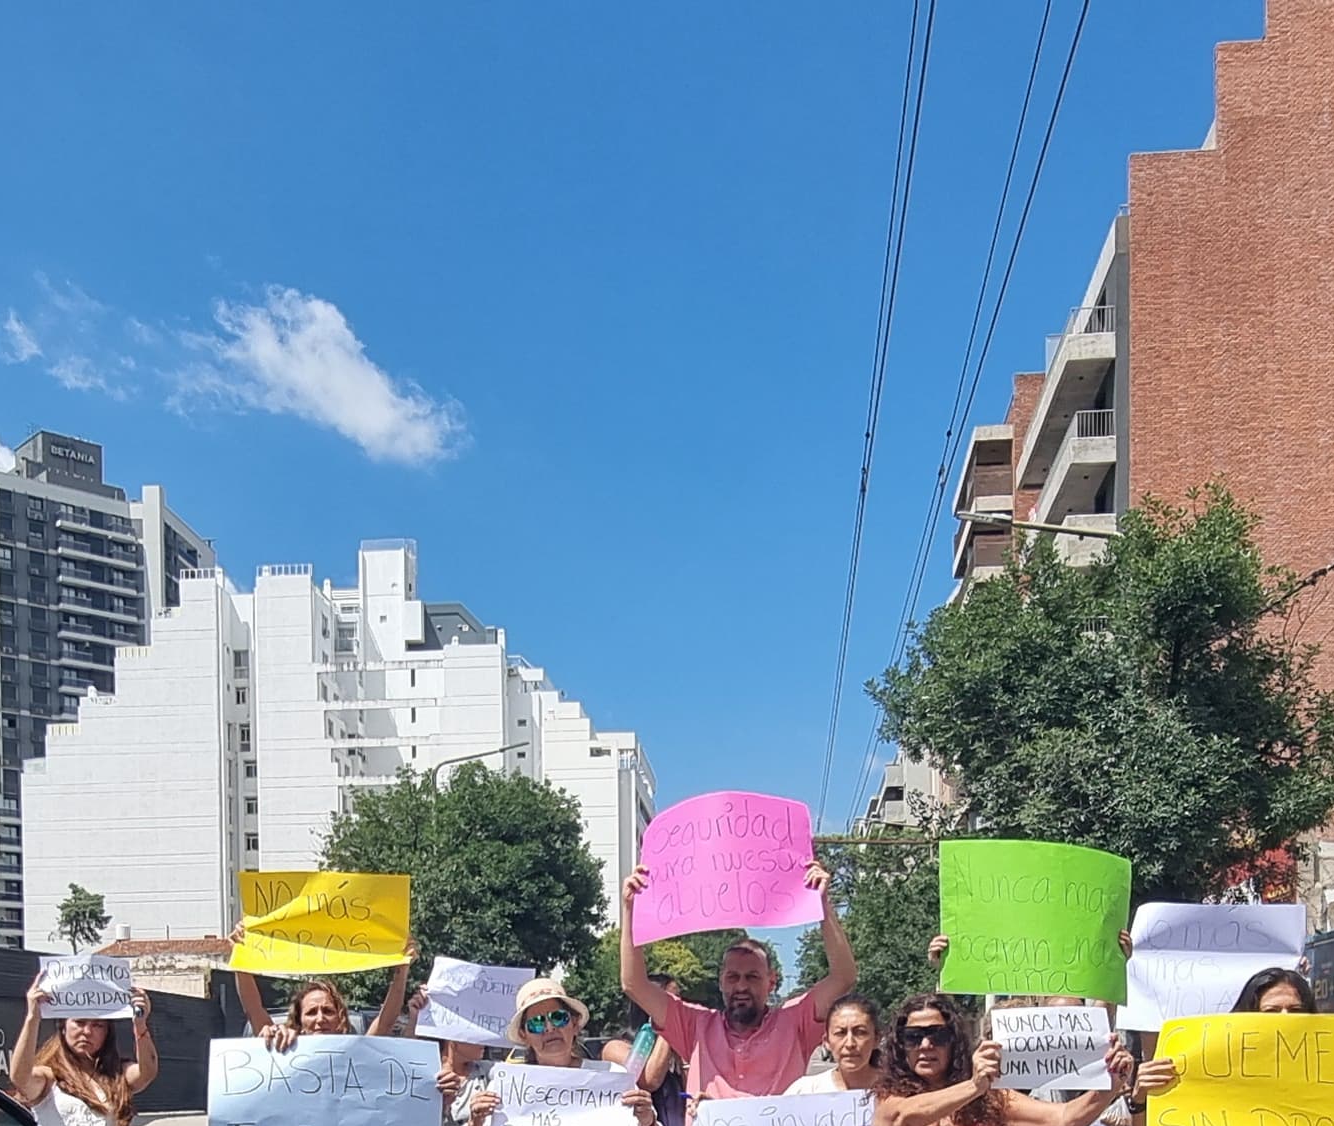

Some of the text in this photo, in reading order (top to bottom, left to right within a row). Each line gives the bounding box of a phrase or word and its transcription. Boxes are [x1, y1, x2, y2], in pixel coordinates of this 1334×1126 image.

[51, 444, 96, 465] BETANIA
[953, 853, 1051, 906] Nunca
[254, 880, 371, 921] NO más
[657, 872, 796, 925] abuelos
[46, 959, 131, 981] QUEREMOS
[48, 985, 131, 1007] SEGURIDAD
[996, 1012, 1094, 1033] NUNCA MAS
[1006, 1032, 1096, 1053] TOCARÁN A
[216, 1050, 431, 1102] BASTA DE
[998, 1054, 1080, 1076] UNA NIÑA
